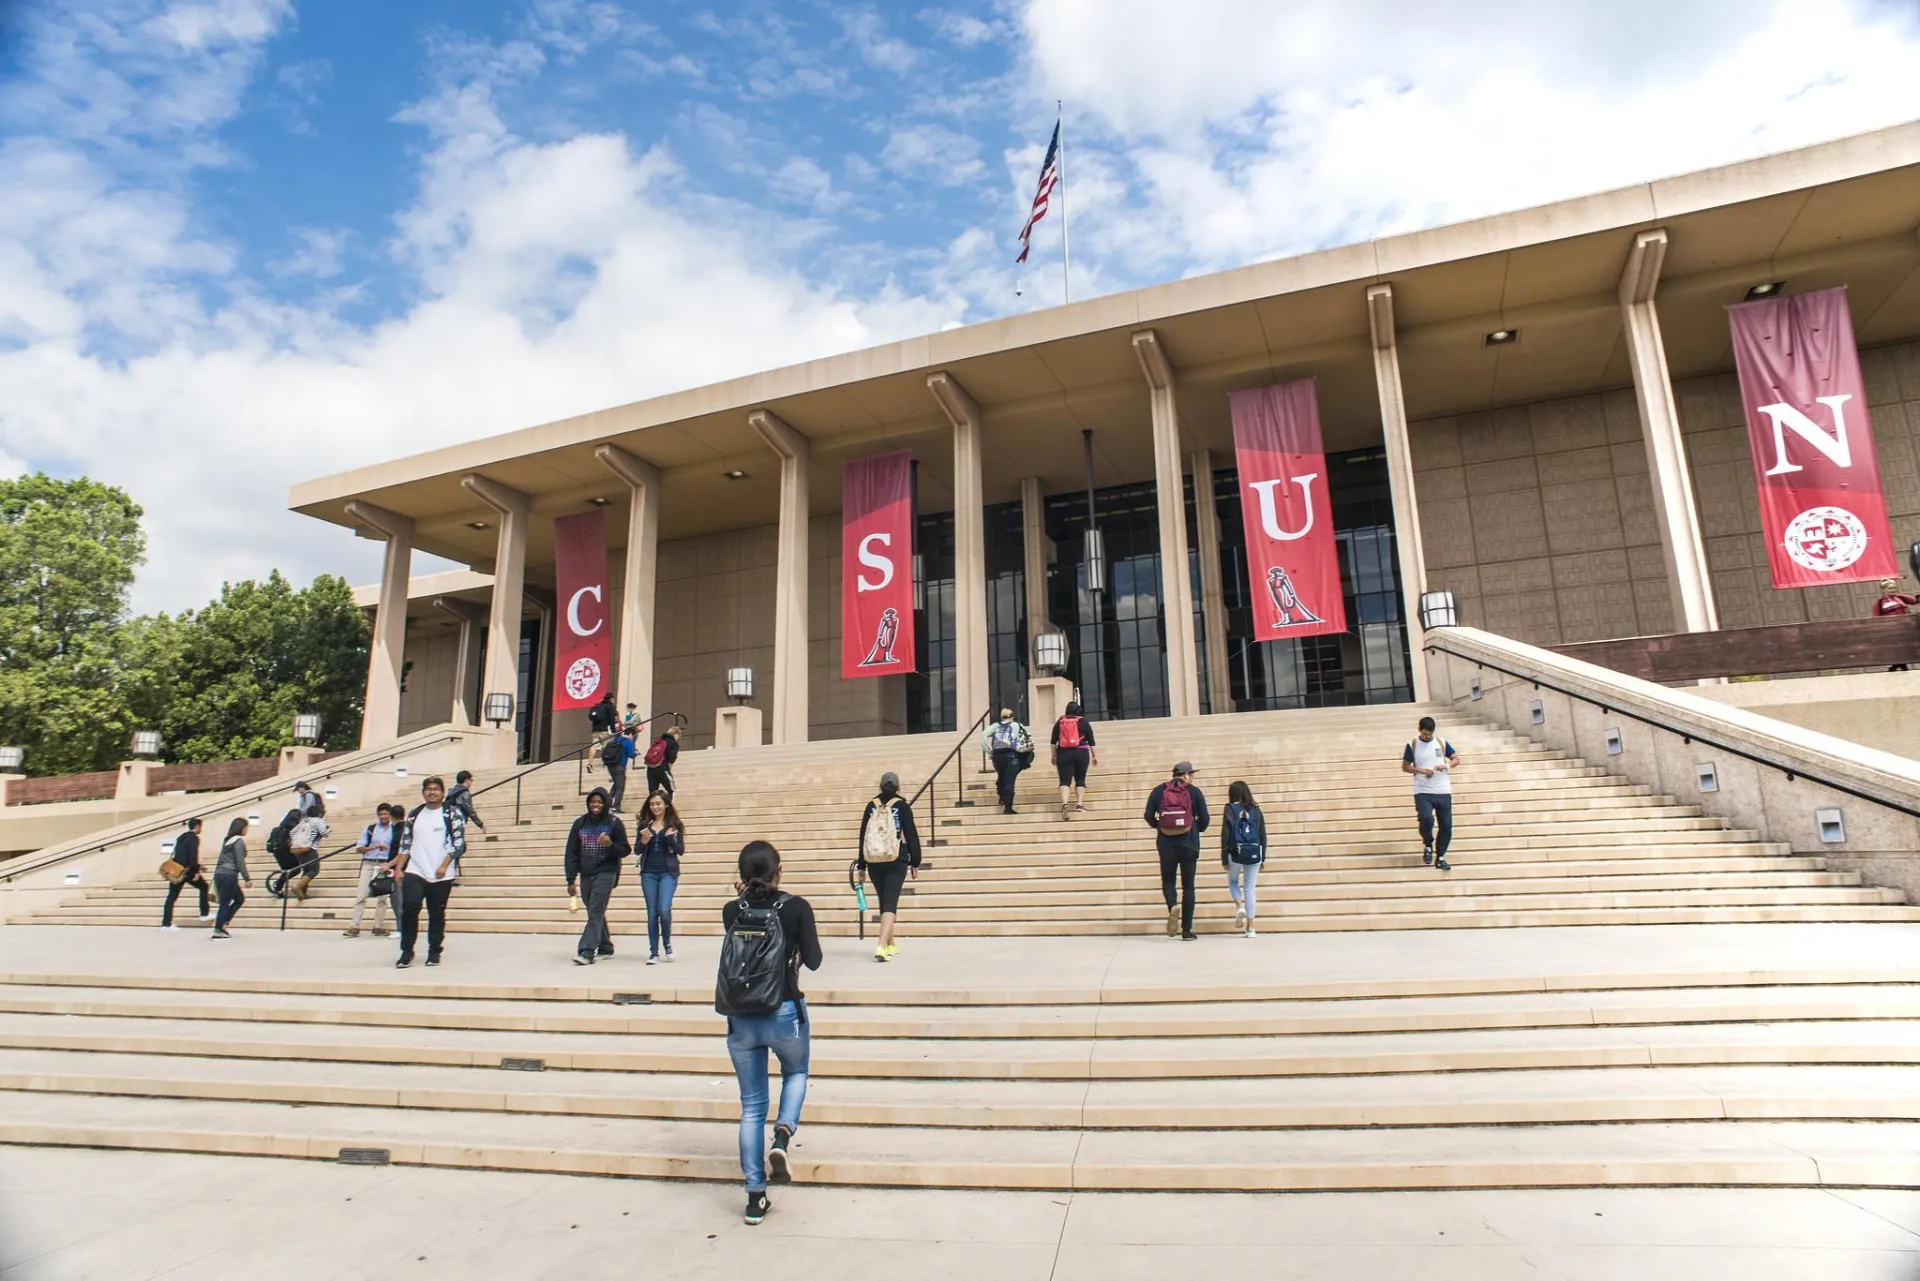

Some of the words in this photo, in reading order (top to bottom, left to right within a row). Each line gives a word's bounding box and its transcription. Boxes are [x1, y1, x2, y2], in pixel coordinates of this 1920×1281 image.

[1757, 394, 1852, 476] N
[1249, 472, 1318, 541] U
[857, 533, 894, 593] S
[567, 584, 603, 636] C
